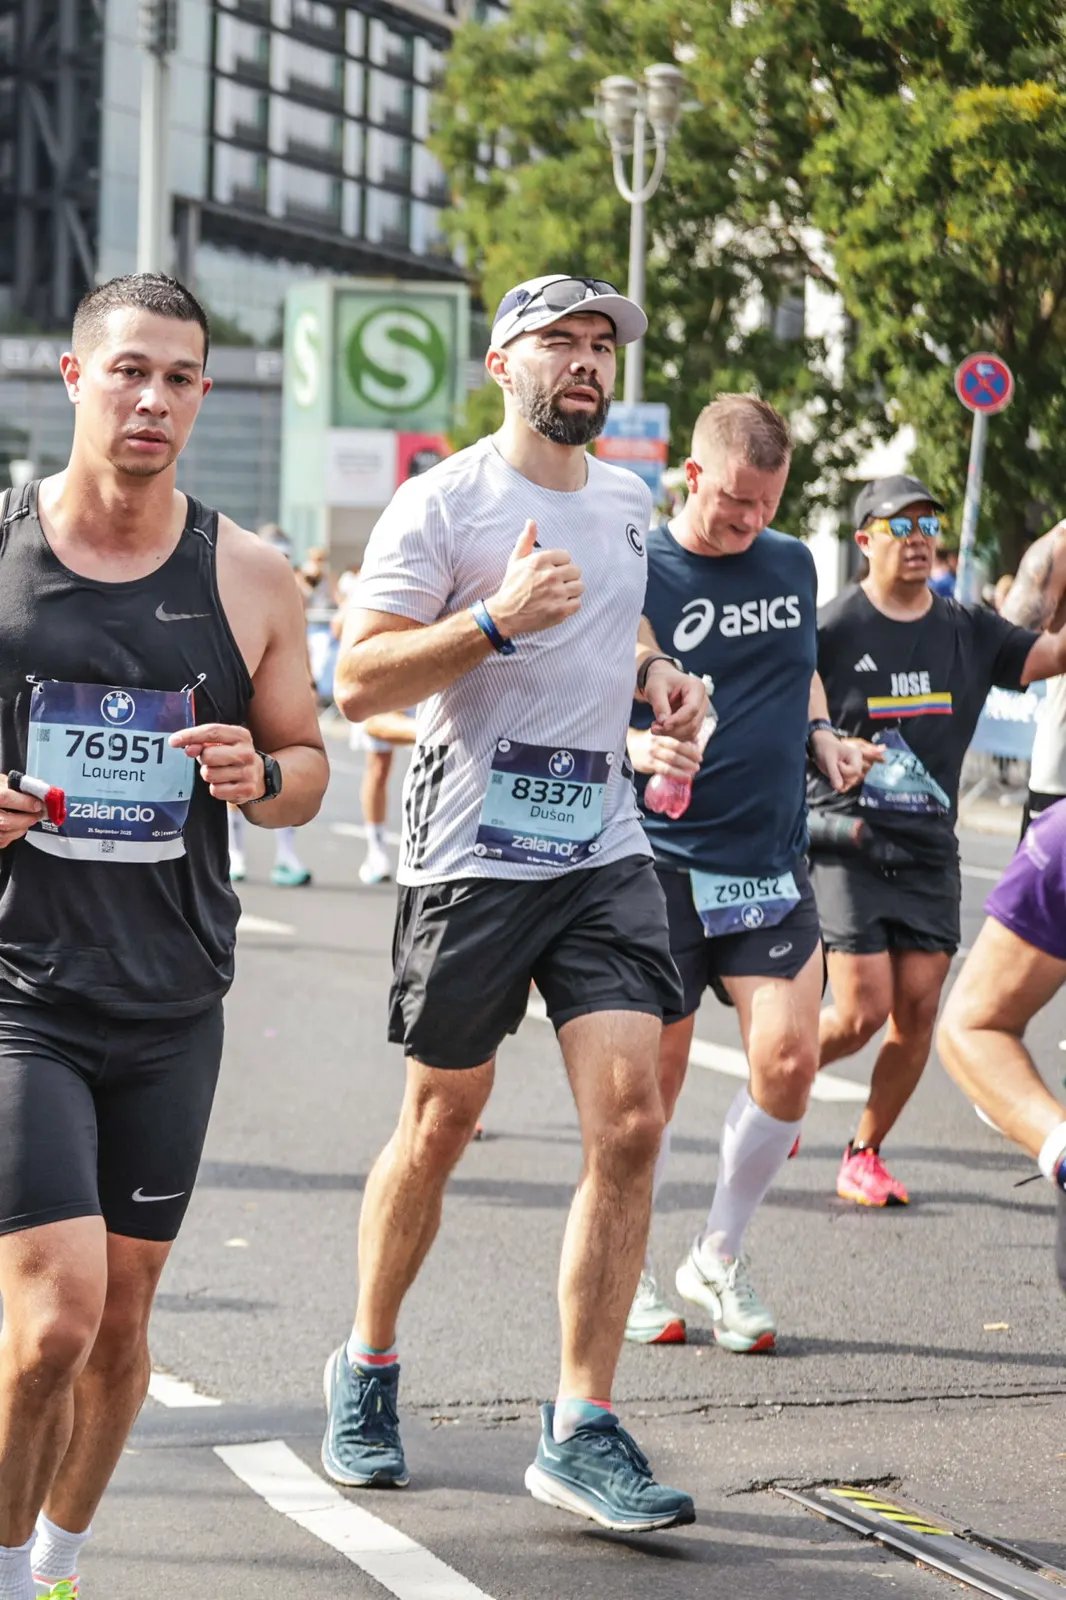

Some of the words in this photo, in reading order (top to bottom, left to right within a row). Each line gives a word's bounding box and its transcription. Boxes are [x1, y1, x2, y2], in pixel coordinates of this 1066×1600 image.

[293, 311, 319, 406] S
[360, 311, 436, 408] S
[719, 595, 801, 638] asics
[891, 671, 932, 697] JOSE
[65, 729, 165, 765] 76951
[82, 762, 146, 783] Laurent
[511, 777, 592, 809] 83370
[69, 802, 155, 823] zalando
[530, 805, 575, 824] Dušan
[714, 876, 782, 903] 25062
